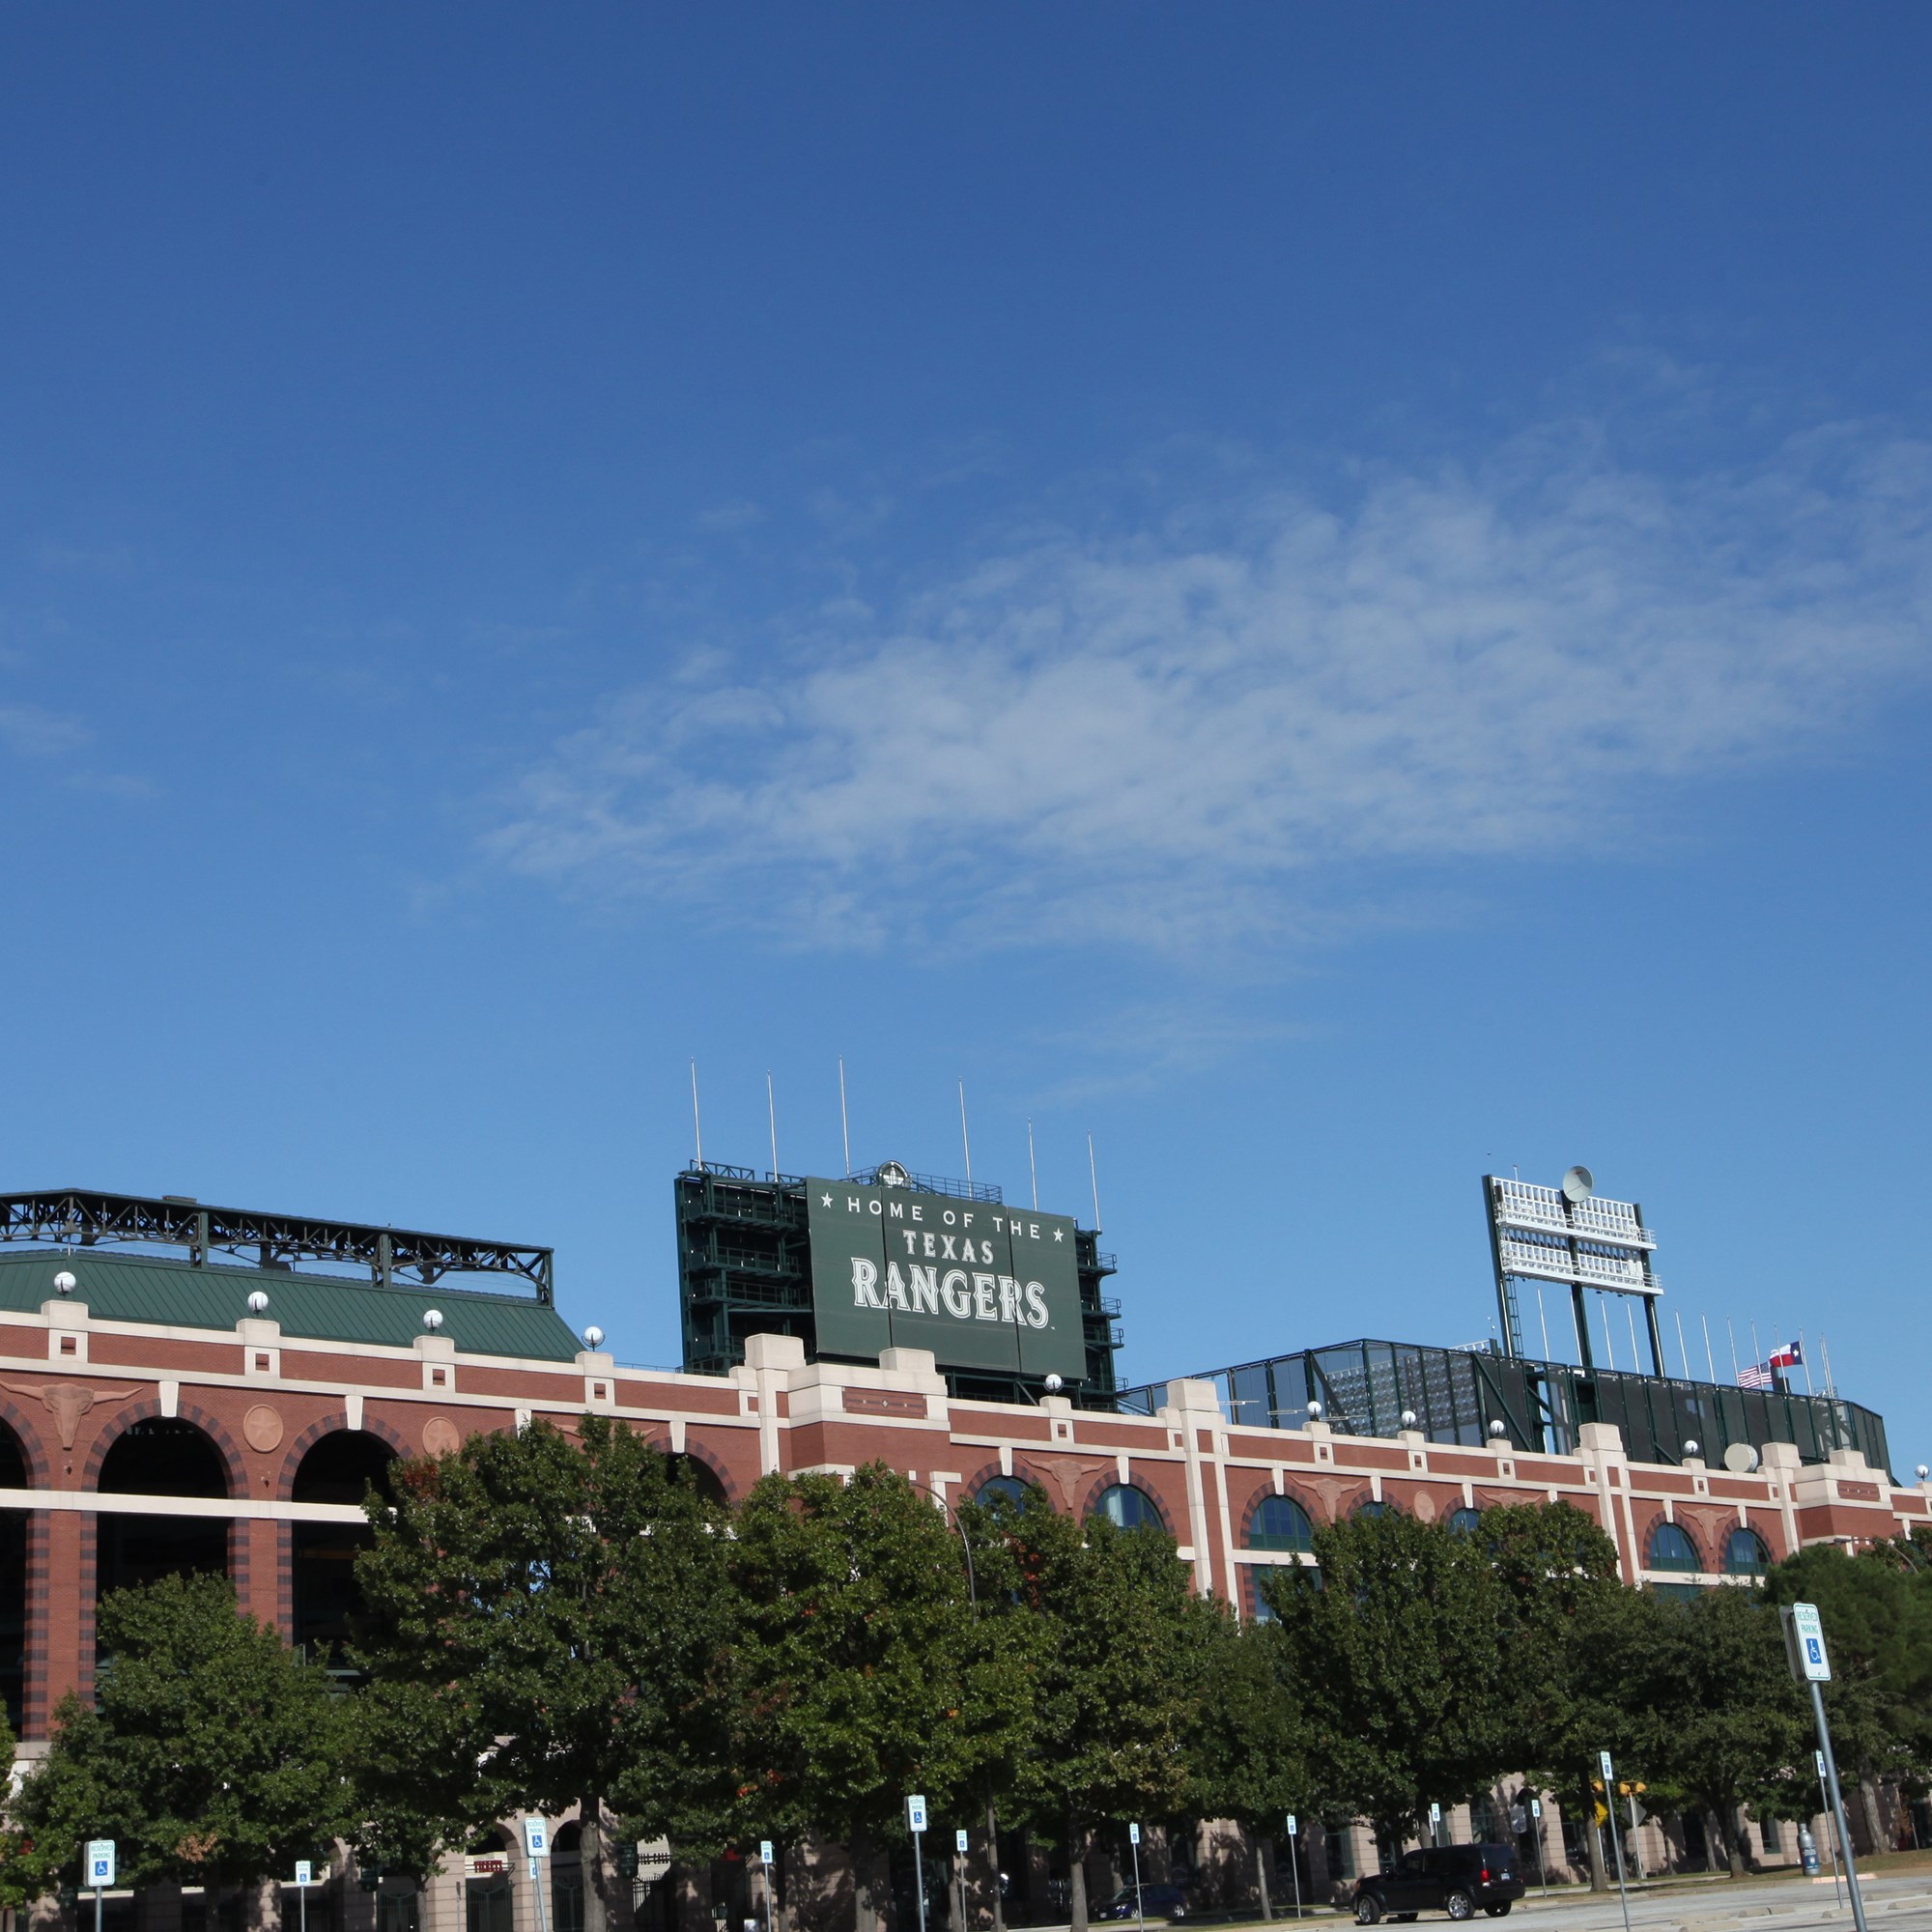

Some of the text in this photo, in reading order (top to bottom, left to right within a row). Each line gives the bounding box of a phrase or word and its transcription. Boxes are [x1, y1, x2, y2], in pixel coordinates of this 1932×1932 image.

[847, 1196, 1040, 1239] HOME OF THE
[903, 1230, 994, 1264] TEXAS
[851, 1257, 1049, 1329] RANGERS
